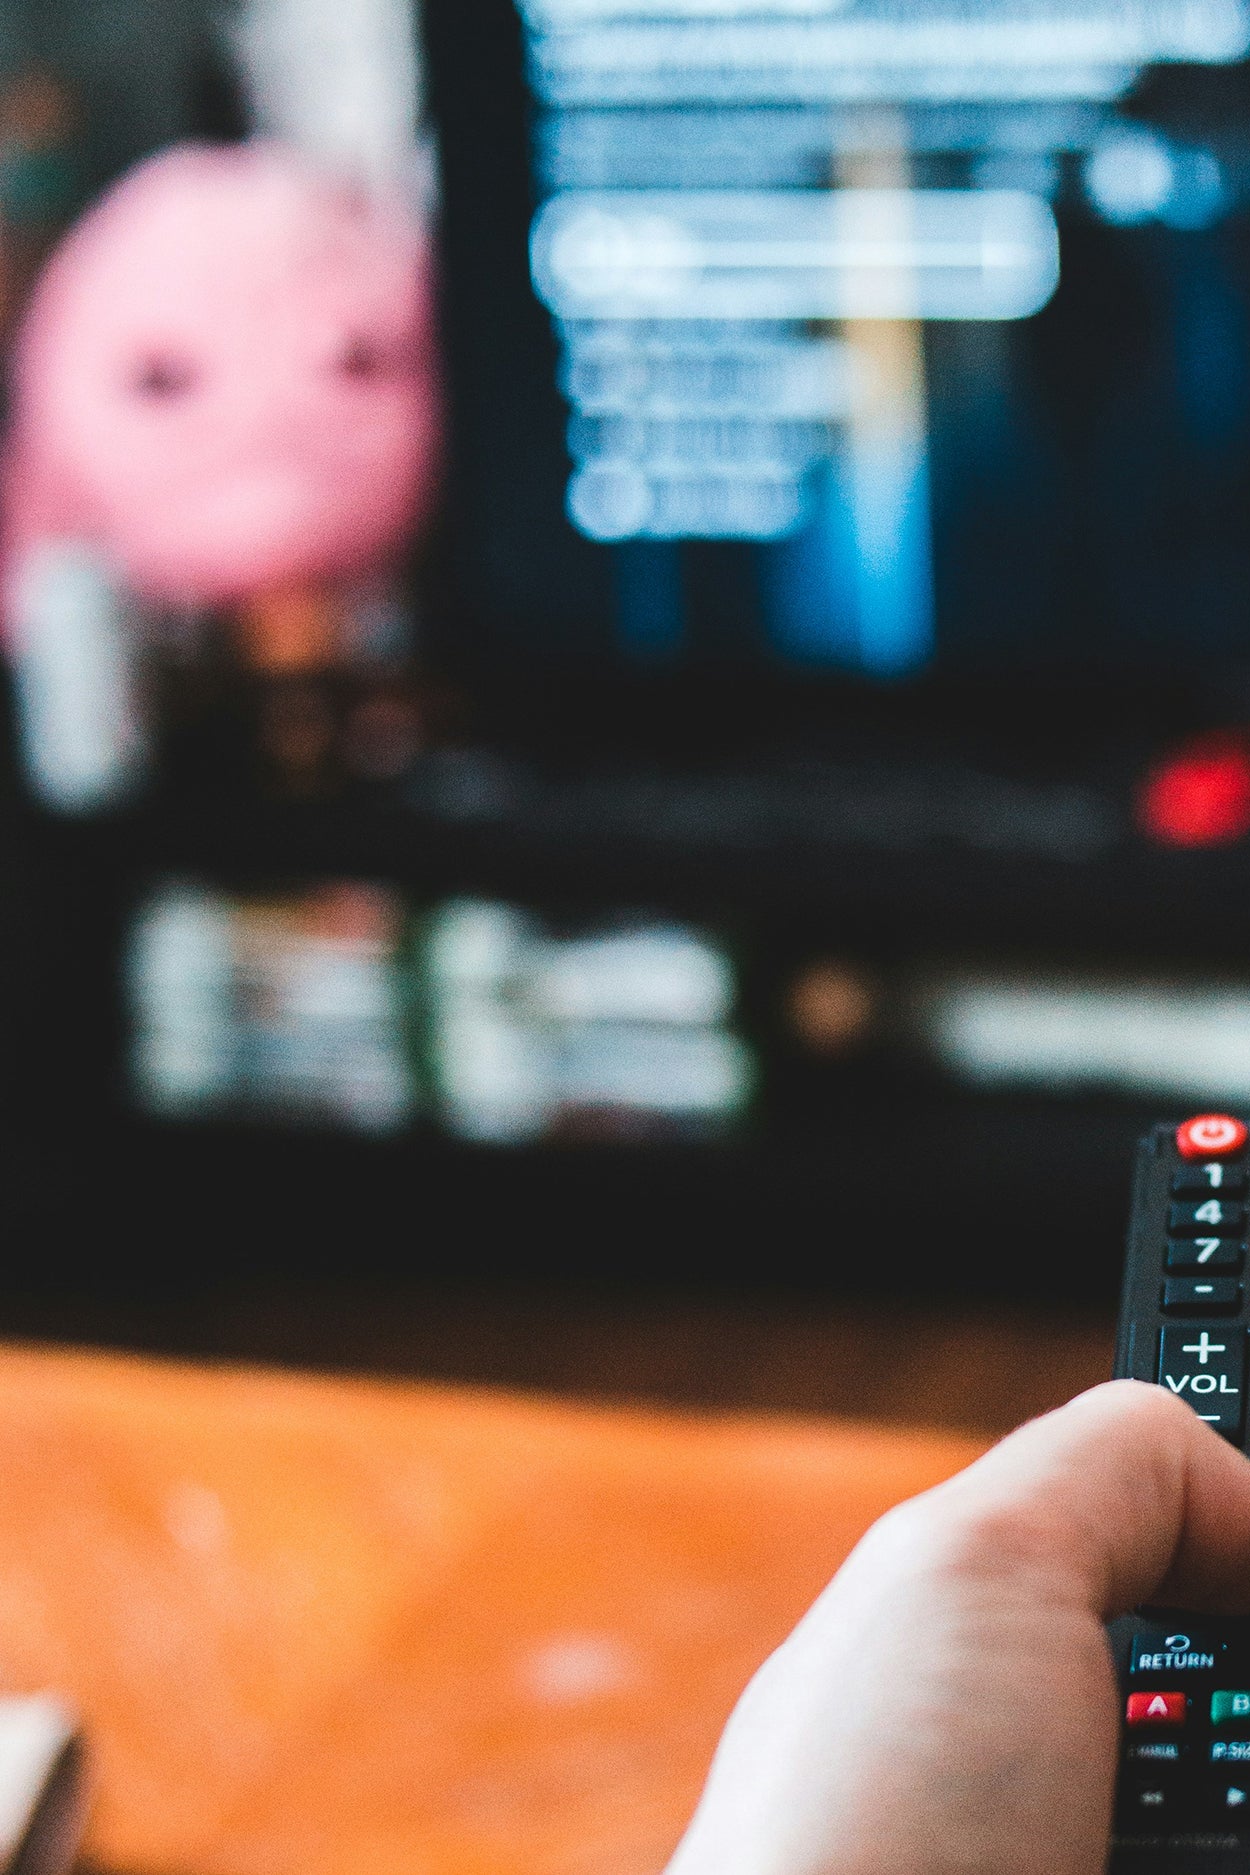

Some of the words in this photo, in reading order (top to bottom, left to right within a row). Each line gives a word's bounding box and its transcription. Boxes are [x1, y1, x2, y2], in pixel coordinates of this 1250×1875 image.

[1204, 1163, 1222, 1187] 1
[1194, 1199, 1222, 1224] 4
[1194, 1238, 1220, 1263] 7
[1166, 1375, 1239, 1394] VOL
[1139, 1653, 1214, 1669] RETURN
[1147, 1695, 1168, 1716] A
[1232, 1694, 1250, 1715] B
